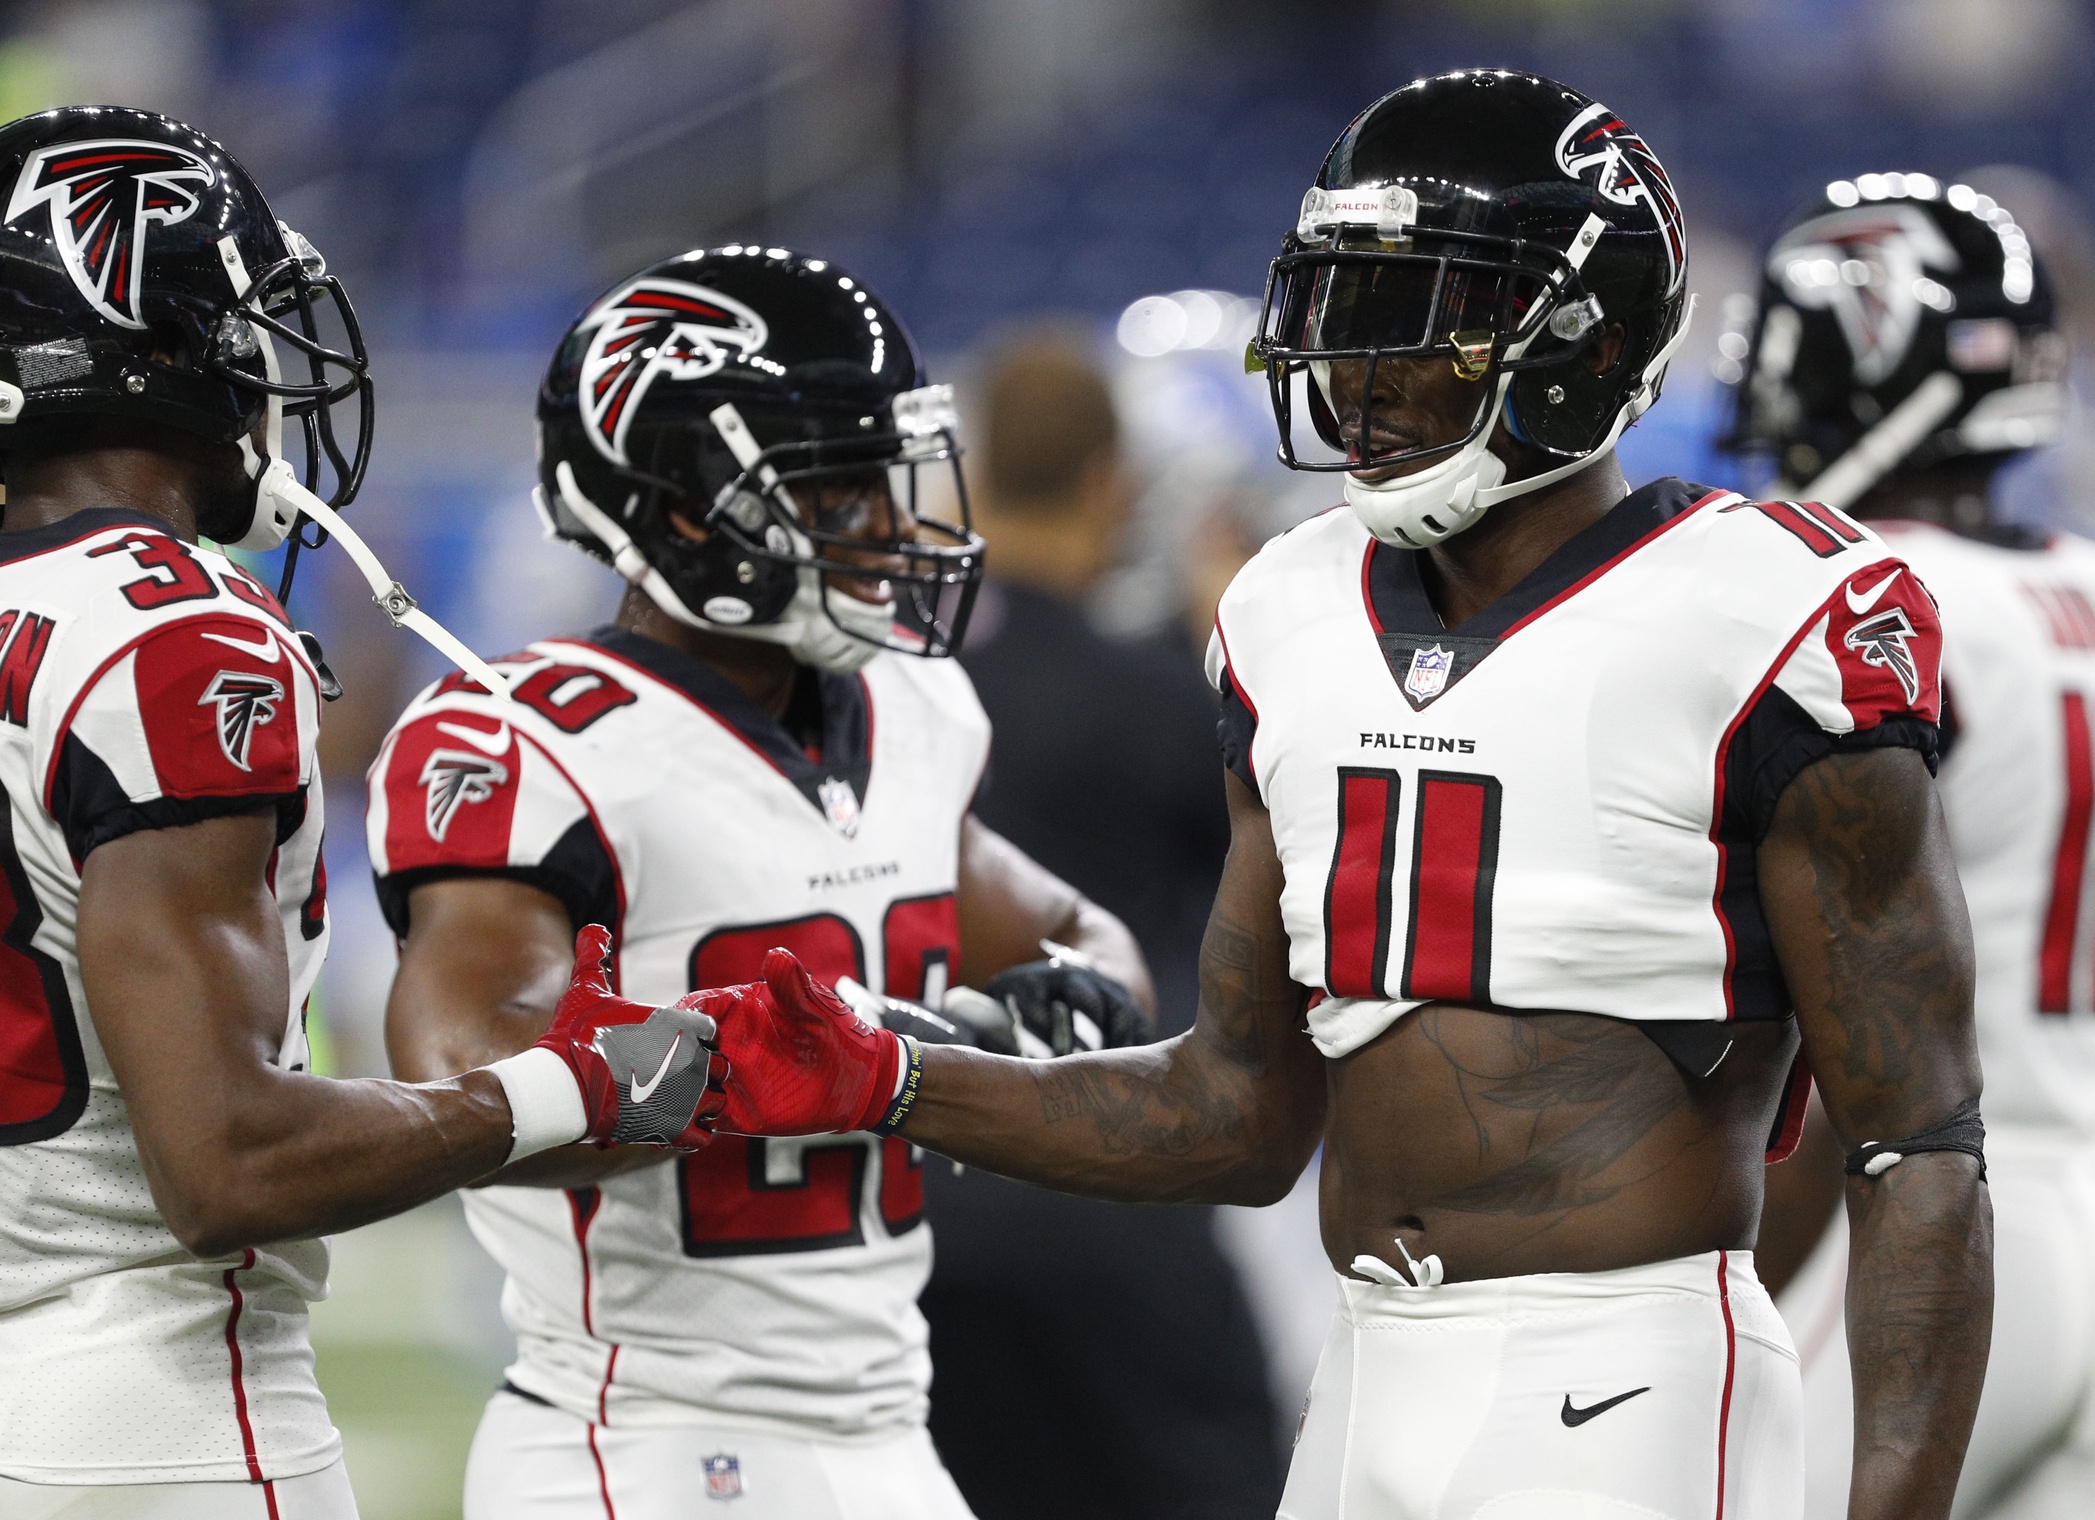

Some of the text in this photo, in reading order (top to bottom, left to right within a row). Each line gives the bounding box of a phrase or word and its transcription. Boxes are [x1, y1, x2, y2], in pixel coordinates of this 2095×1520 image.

[1335, 203, 1378, 211] FALCON
[1412, 668, 1439, 692] NFL
[1359, 732, 1476, 754] FALCONS
[1323, 765, 1503, 1003] 11
[907, 1069, 921, 1089] But
[901, 1089, 916, 1105] His
[888, 1106, 909, 1126] Love
